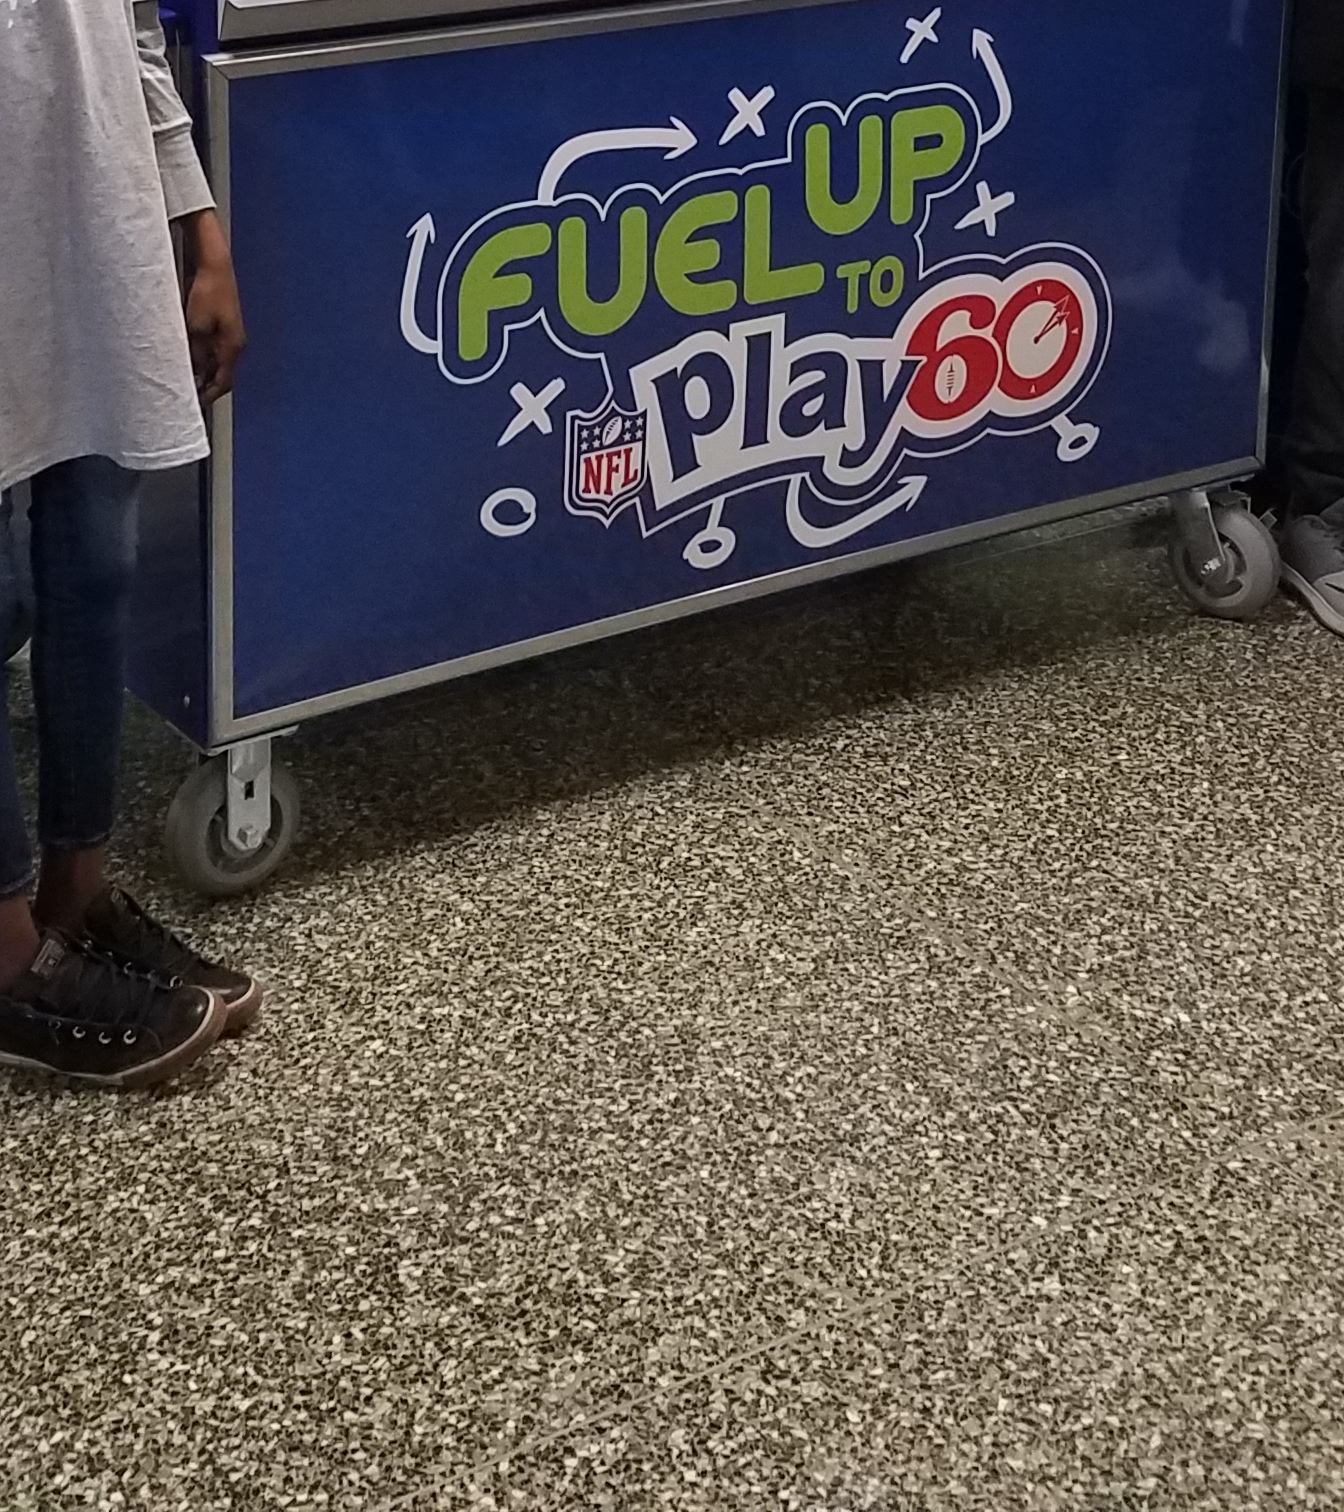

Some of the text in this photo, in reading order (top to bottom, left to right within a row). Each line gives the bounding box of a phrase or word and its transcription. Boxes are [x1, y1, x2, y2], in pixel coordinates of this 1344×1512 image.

[457, 104, 968, 362] FUEL UP
[837, 255, 904, 314] TO
[580, 443, 641, 494] NFL
